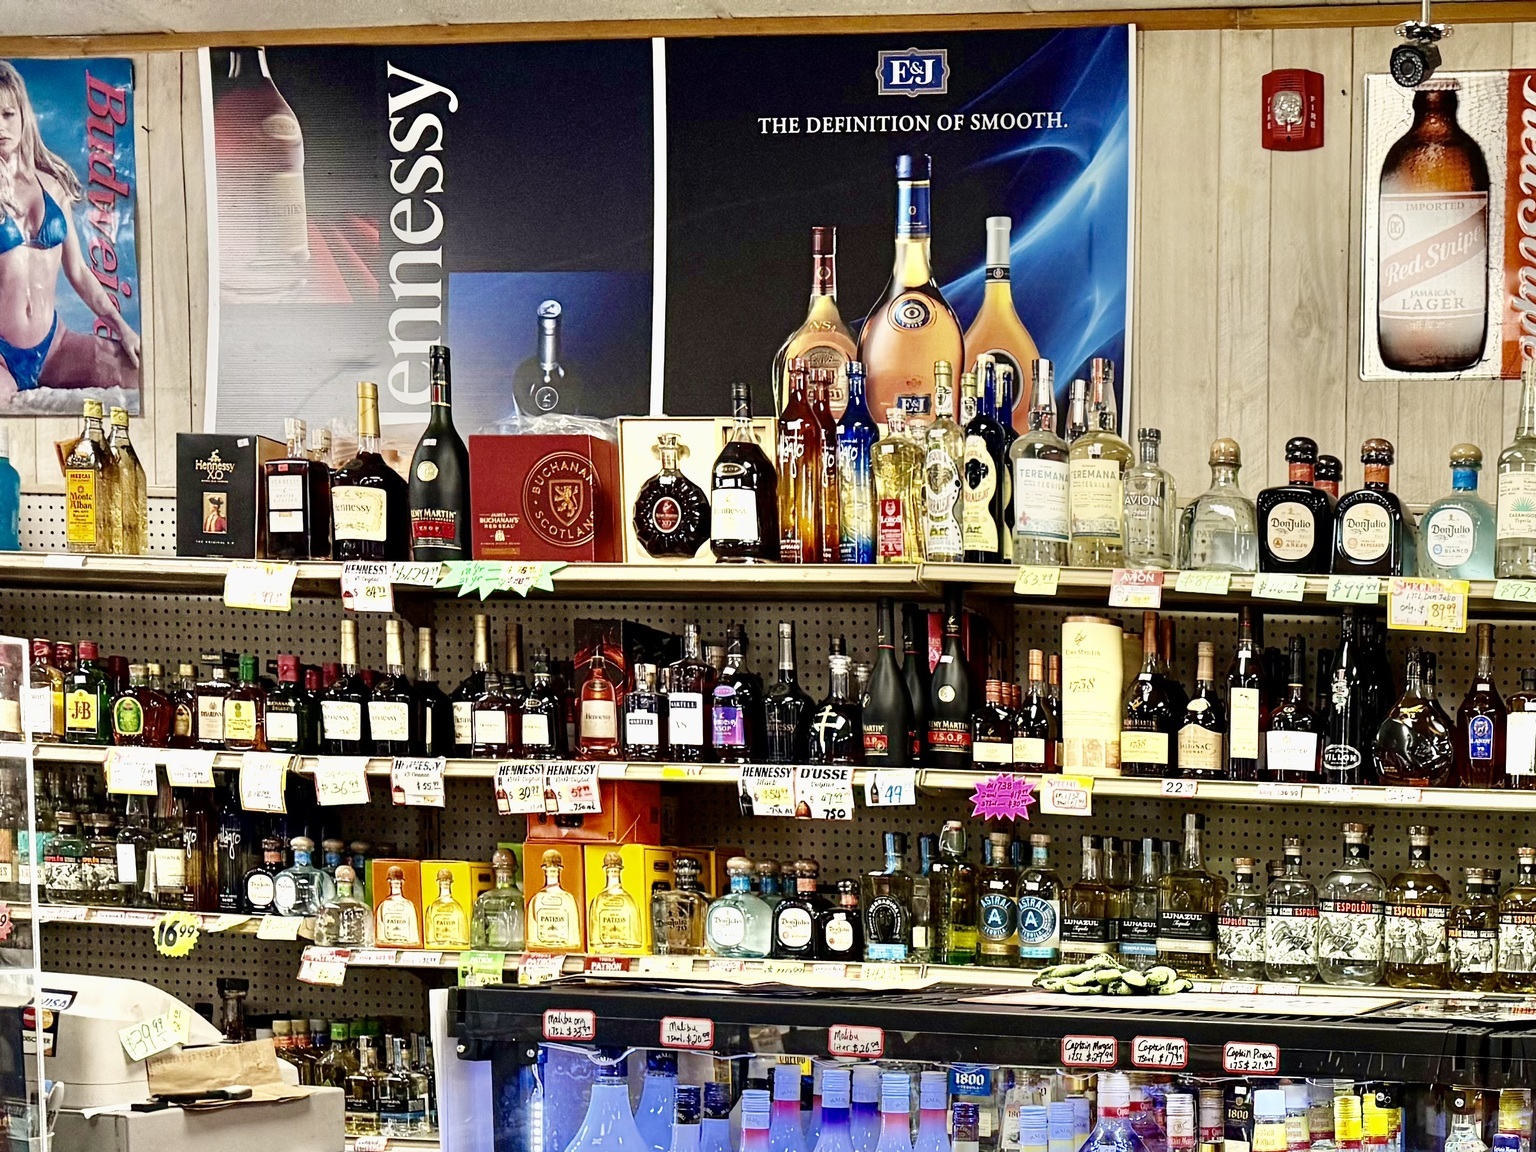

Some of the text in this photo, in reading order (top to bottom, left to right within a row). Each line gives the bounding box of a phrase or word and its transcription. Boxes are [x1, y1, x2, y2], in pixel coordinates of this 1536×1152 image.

[889, 57, 935, 85] E&J
[758, 111, 1068, 134] THE DEFINITION OF SMOOTH.
[1406, 201, 1464, 212] IMPORTED
[1385, 253, 1426, 287] Red
[1409, 289, 1456, 299] JAMAICAN
[1401, 297, 1465, 310] LAGER
[195, 458, 235, 471] Hennessy
[1020, 467, 1067, 478] TEREMANA
[1071, 469, 1116, 479] TEREMANA
[1069, 676, 1095, 691] 1738
[70, 701, 91, 719] J&B
[547, 764, 596, 775] HENNESSY
[743, 768, 792, 778] HENNESSY
[980, 895, 1014, 910] ASTRAL
[1063, 919, 1098, 927] LUNAZUL
[1162, 913, 1202, 922] LUNAZUL
[954, 1073, 985, 1085] 1800
